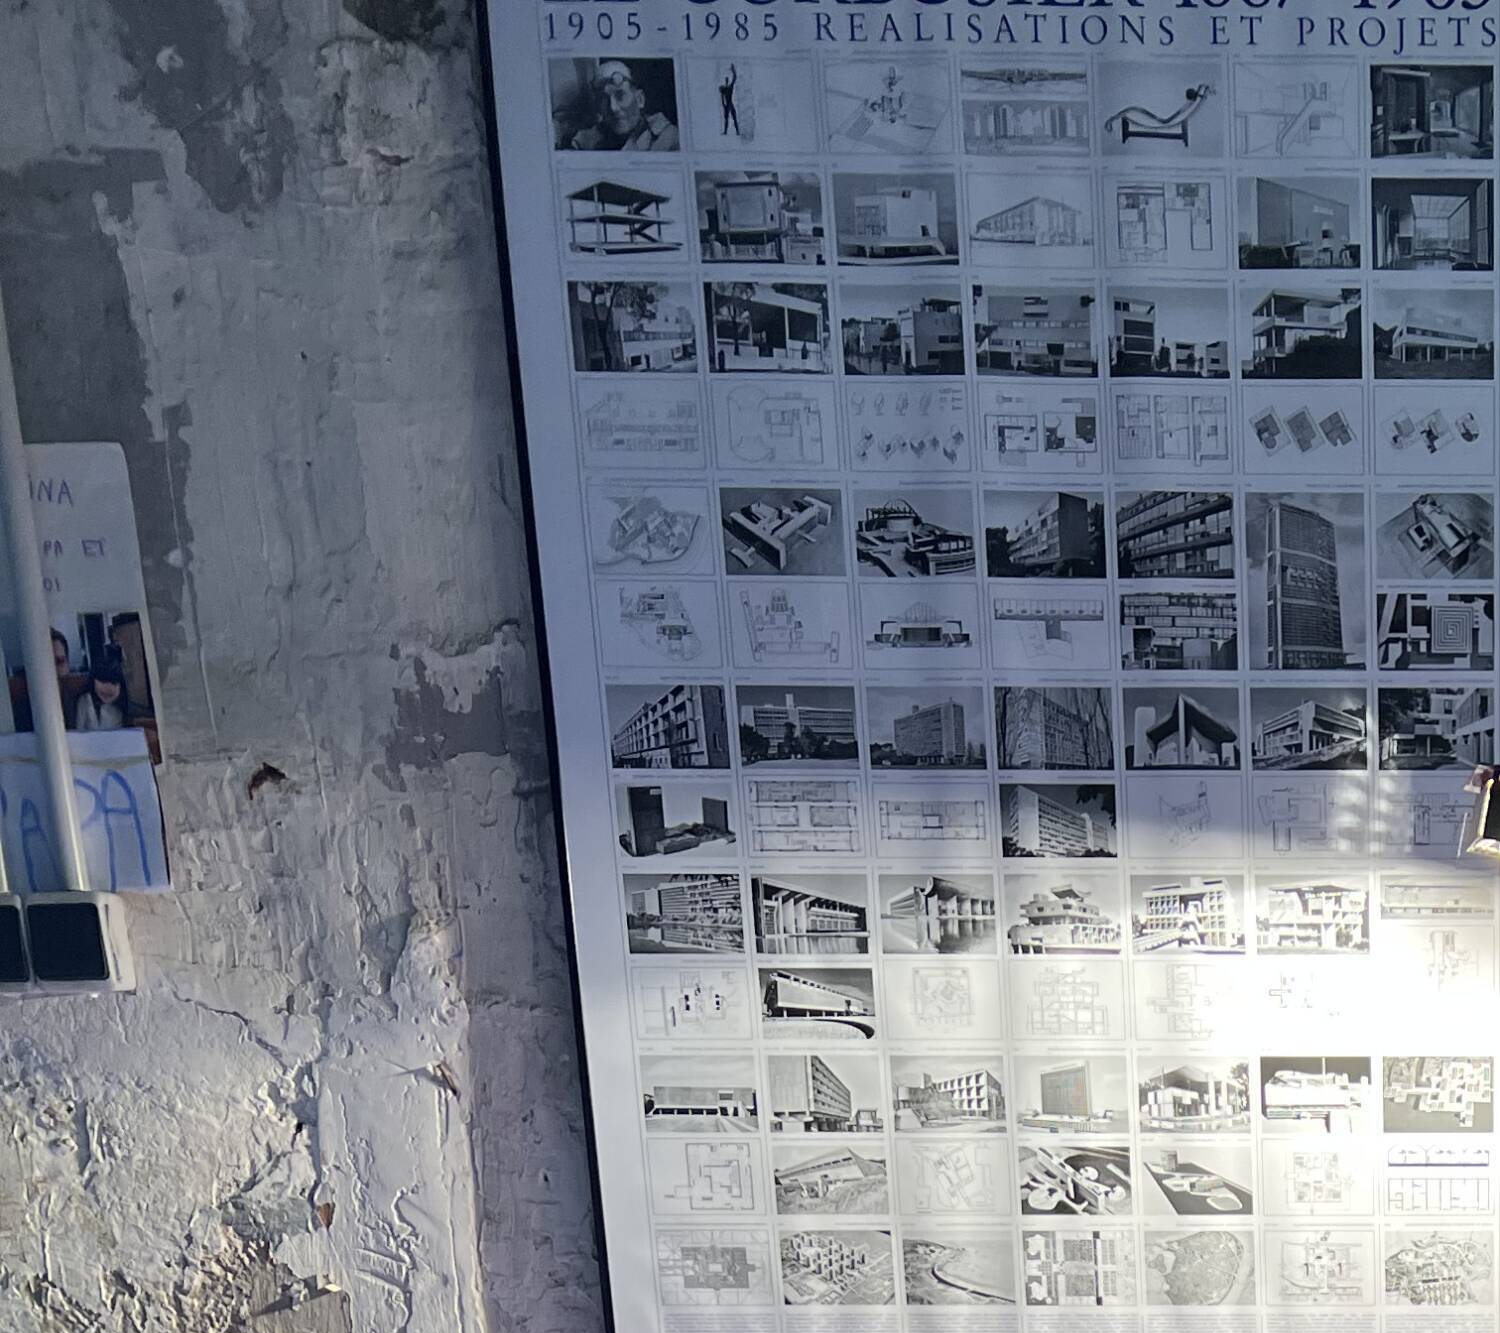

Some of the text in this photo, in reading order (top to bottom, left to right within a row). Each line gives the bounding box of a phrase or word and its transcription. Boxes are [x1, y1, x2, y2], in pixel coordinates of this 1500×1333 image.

[544, 12, 1498, 56] 1905-1985 REALISATIONS ET PROJETS
